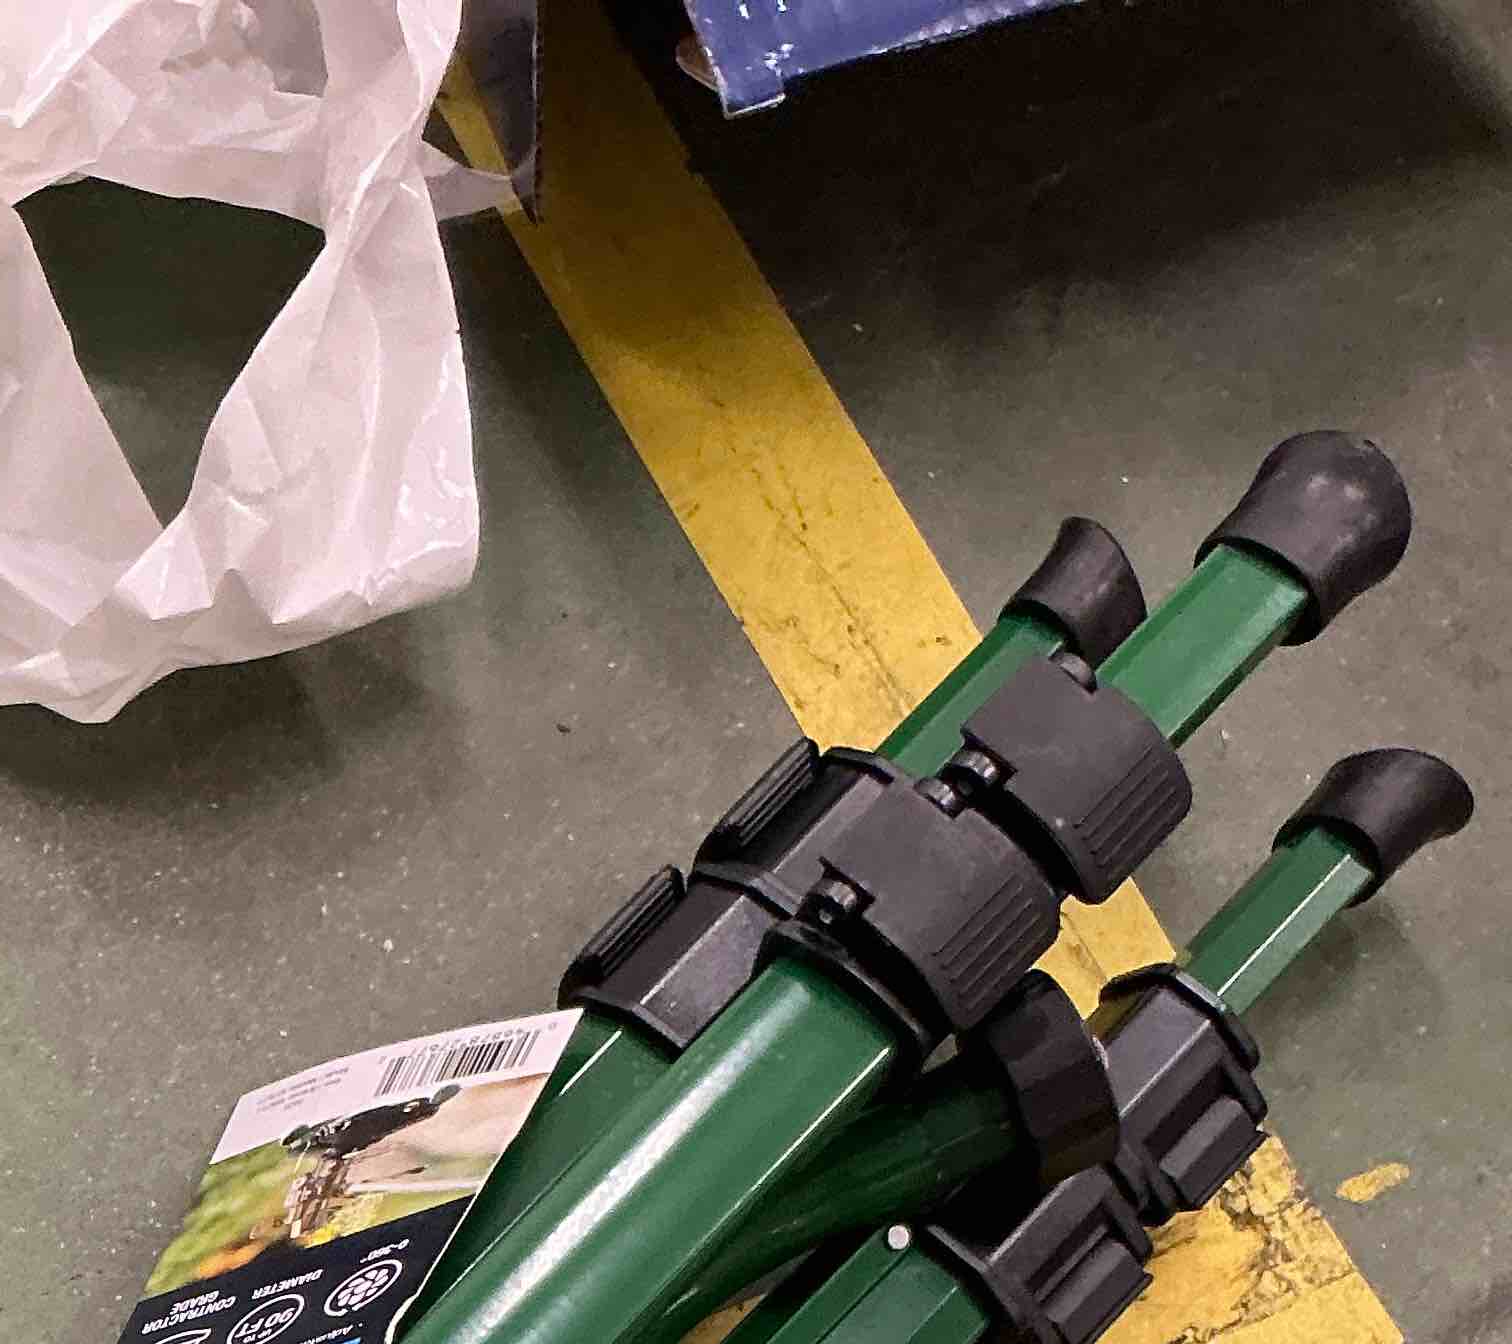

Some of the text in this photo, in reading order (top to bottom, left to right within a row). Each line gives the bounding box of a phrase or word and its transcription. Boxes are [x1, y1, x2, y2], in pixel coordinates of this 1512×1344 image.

[252, 1269, 324, 1300] DIAMETER
[141, 1295, 237, 1335] CONTRACTOR
[169, 1290, 220, 1316] GRADE
[236, 1307, 295, 1338] 90 FT
[243, 1328, 273, 1344] UP TO
